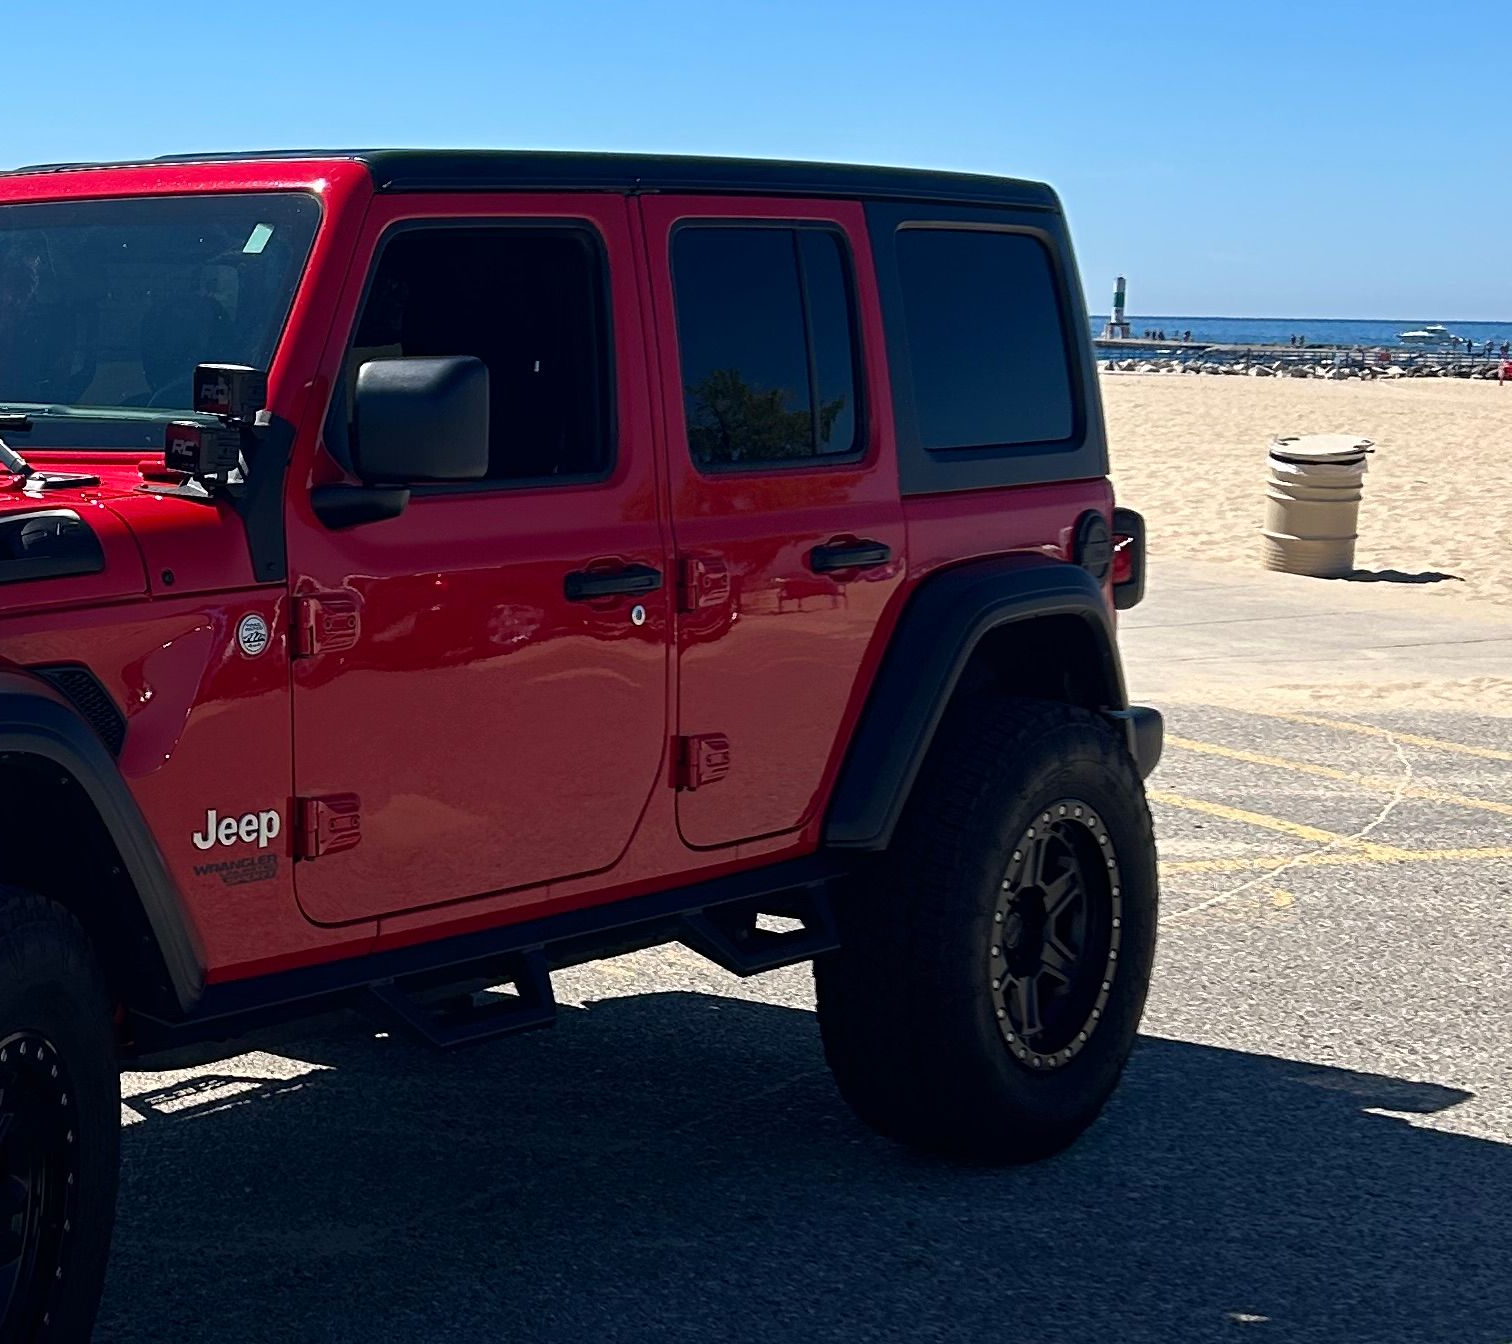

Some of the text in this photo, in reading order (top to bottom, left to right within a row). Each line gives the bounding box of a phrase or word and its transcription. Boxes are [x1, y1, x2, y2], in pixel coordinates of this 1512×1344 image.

[172, 439, 195, 456] RC
[192, 809, 280, 850] Jeep
[193, 854, 278, 875] WRANGLER
